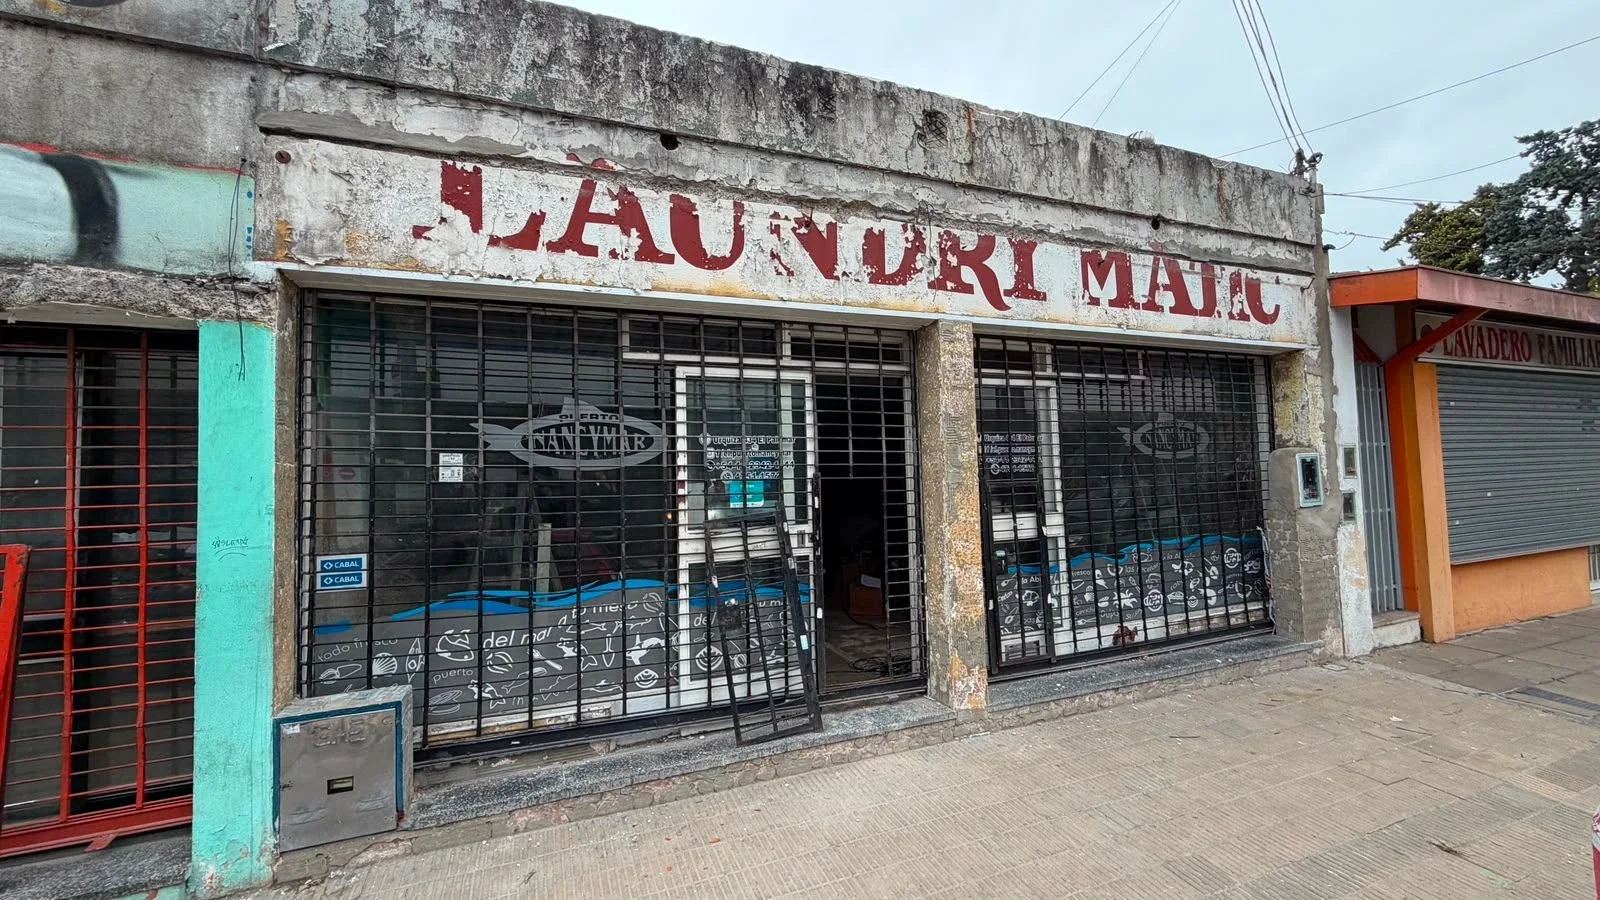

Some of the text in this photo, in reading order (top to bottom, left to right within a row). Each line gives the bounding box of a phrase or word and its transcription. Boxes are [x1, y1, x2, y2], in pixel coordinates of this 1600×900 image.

[411, 153, 1047, 311] LAUNDRI
[1442, 323, 1532, 363] LAVADERO
[334, 575, 360, 583] CABAL
[482, 630, 515, 651] del
[521, 626, 552, 645] mar
[318, 643, 351, 662] todo
[432, 668, 474, 684] puerto
